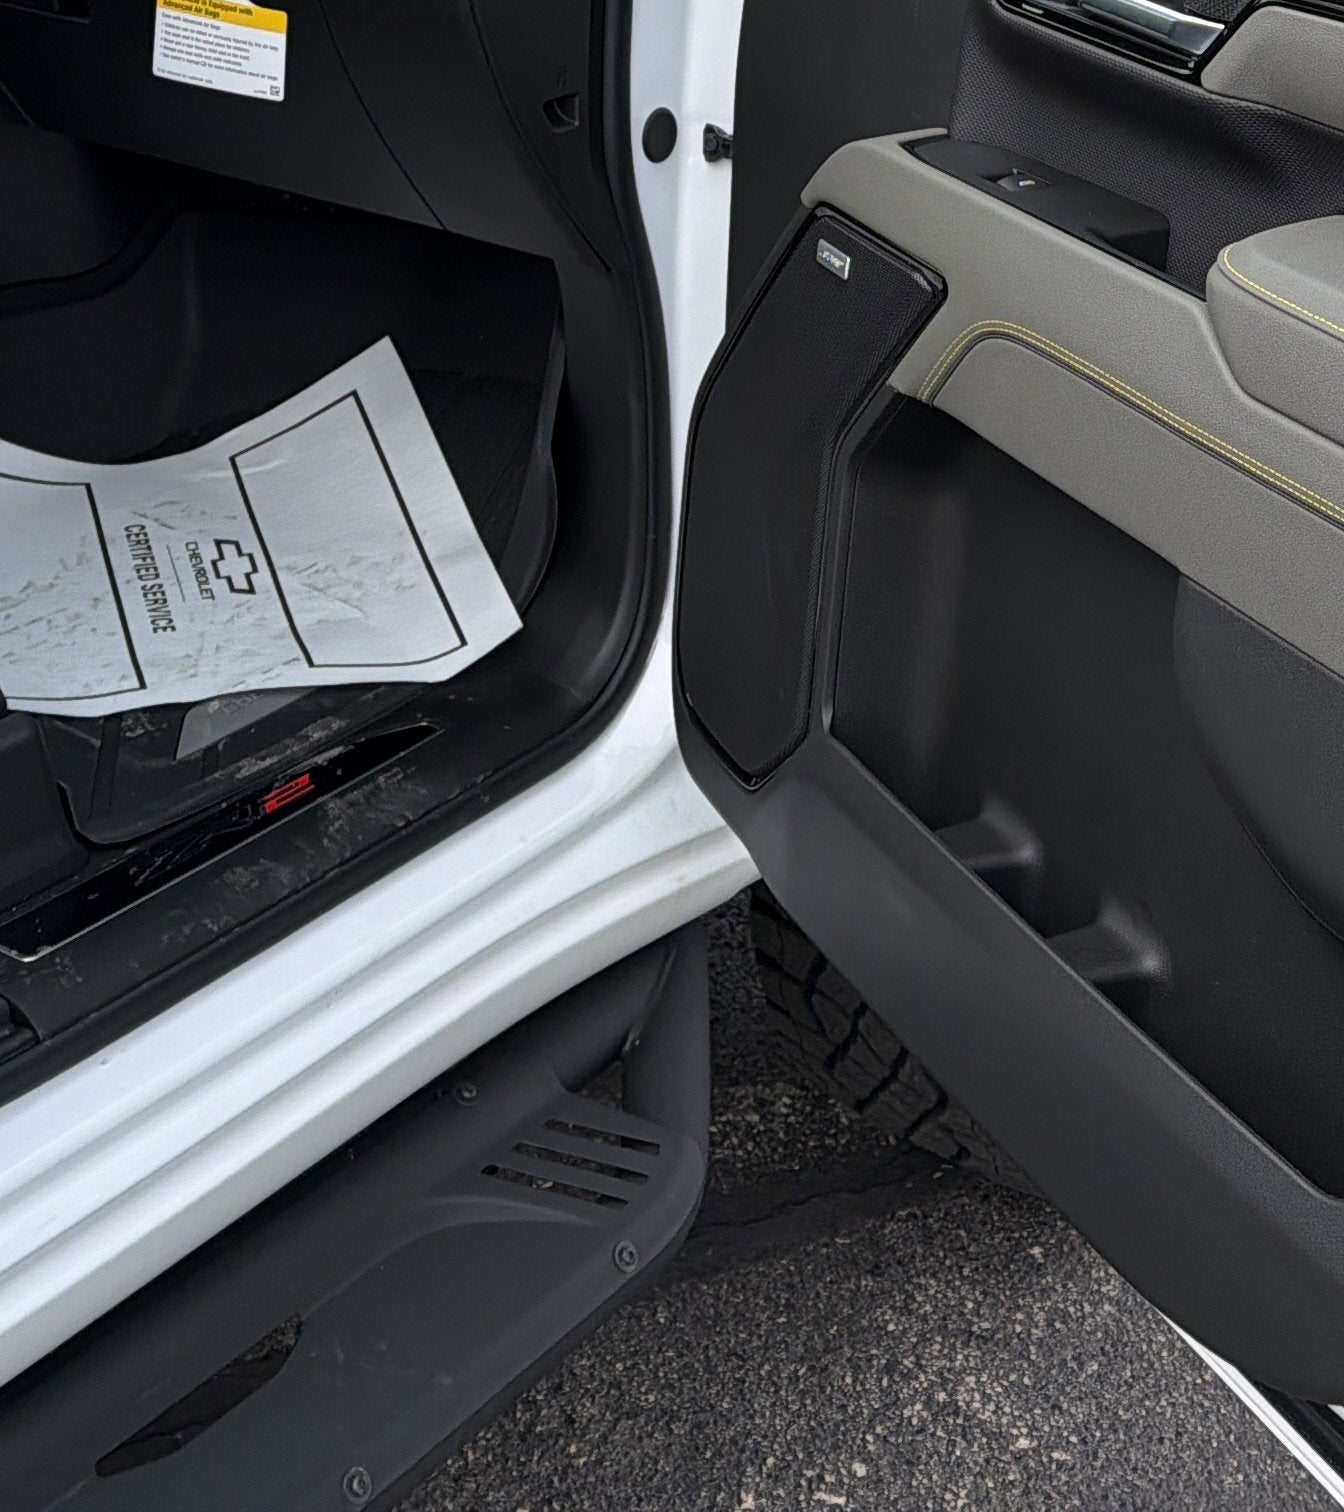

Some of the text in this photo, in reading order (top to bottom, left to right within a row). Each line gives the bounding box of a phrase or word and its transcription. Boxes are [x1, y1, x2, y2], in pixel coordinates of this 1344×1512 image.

[124, 524, 176, 633] CERTIFIED SERVICE
[185, 541, 215, 601] CHEVROLET
